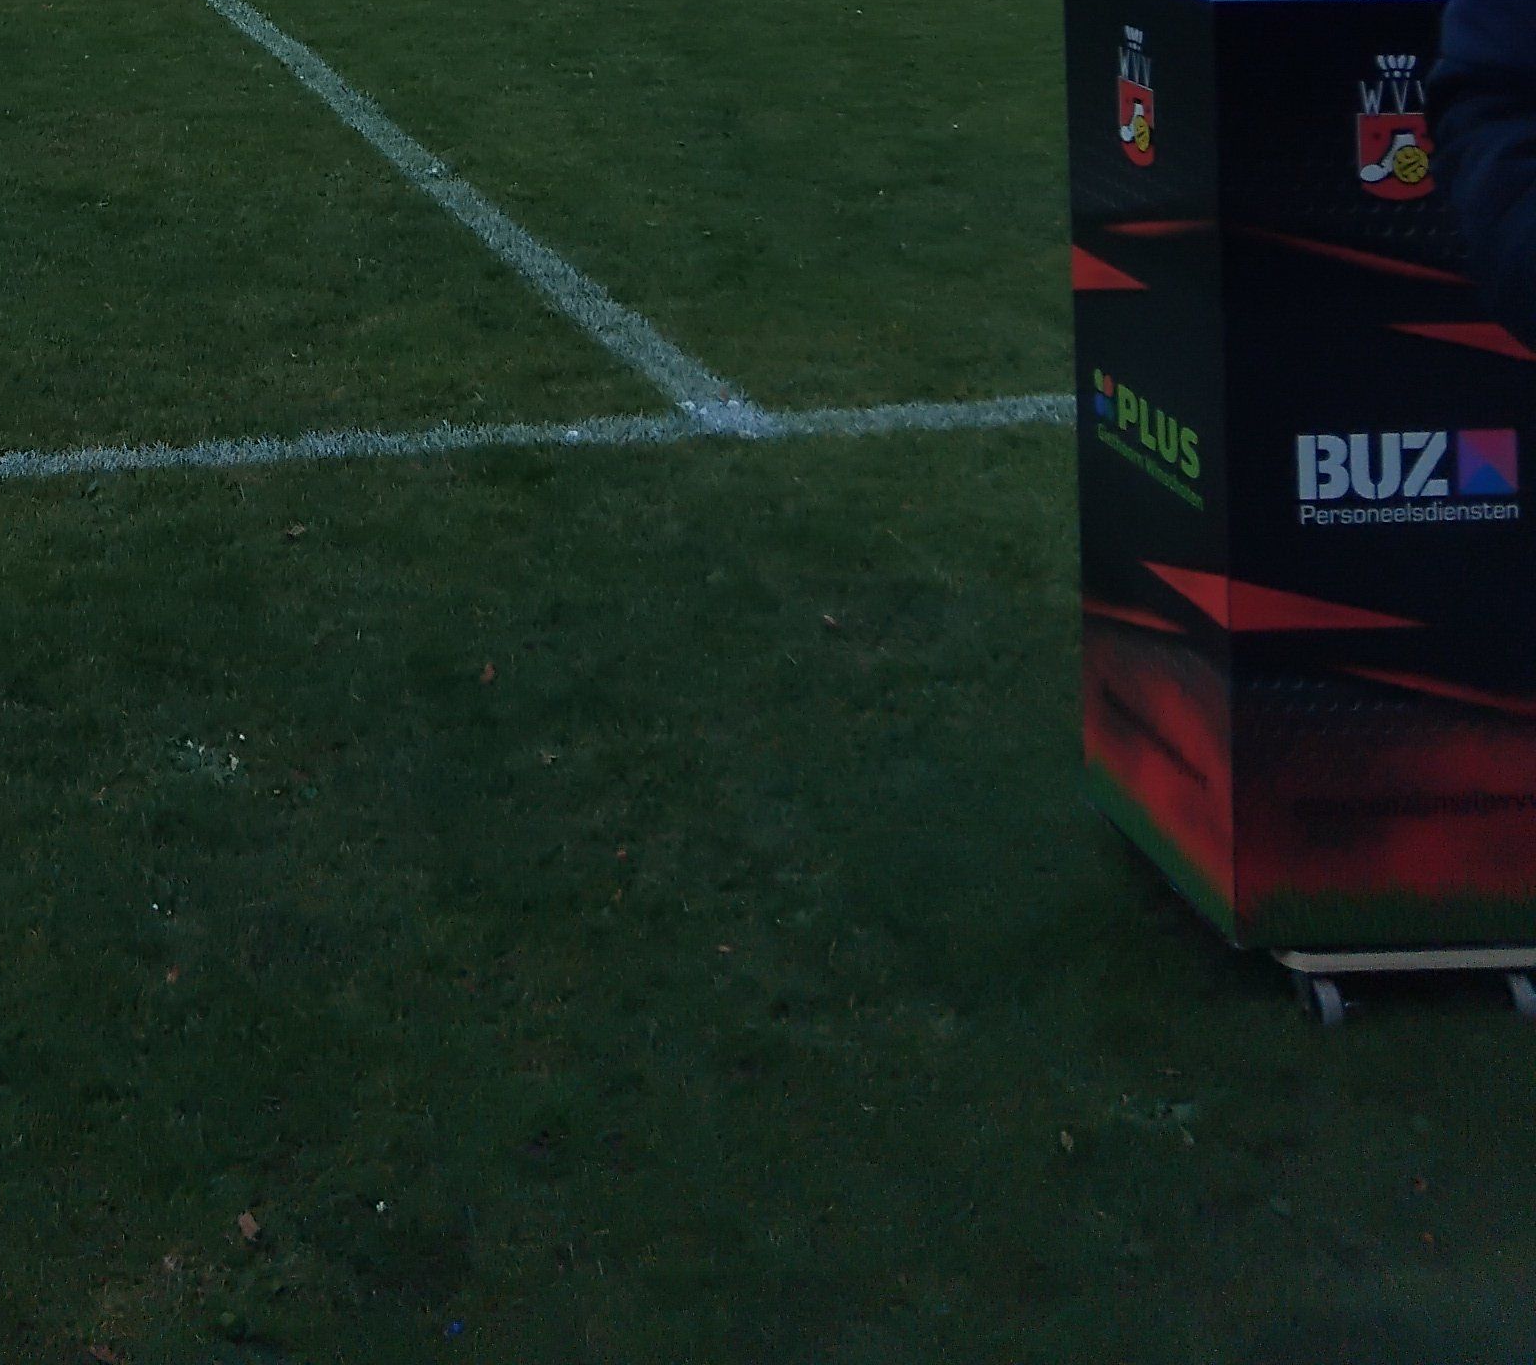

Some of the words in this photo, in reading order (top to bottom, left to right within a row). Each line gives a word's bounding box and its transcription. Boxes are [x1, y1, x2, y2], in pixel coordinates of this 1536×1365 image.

[1117, 383, 1200, 479] PLUS
[1296, 429, 1449, 501] BUZ
[1299, 502, 1520, 526] Personeelsdiensten
